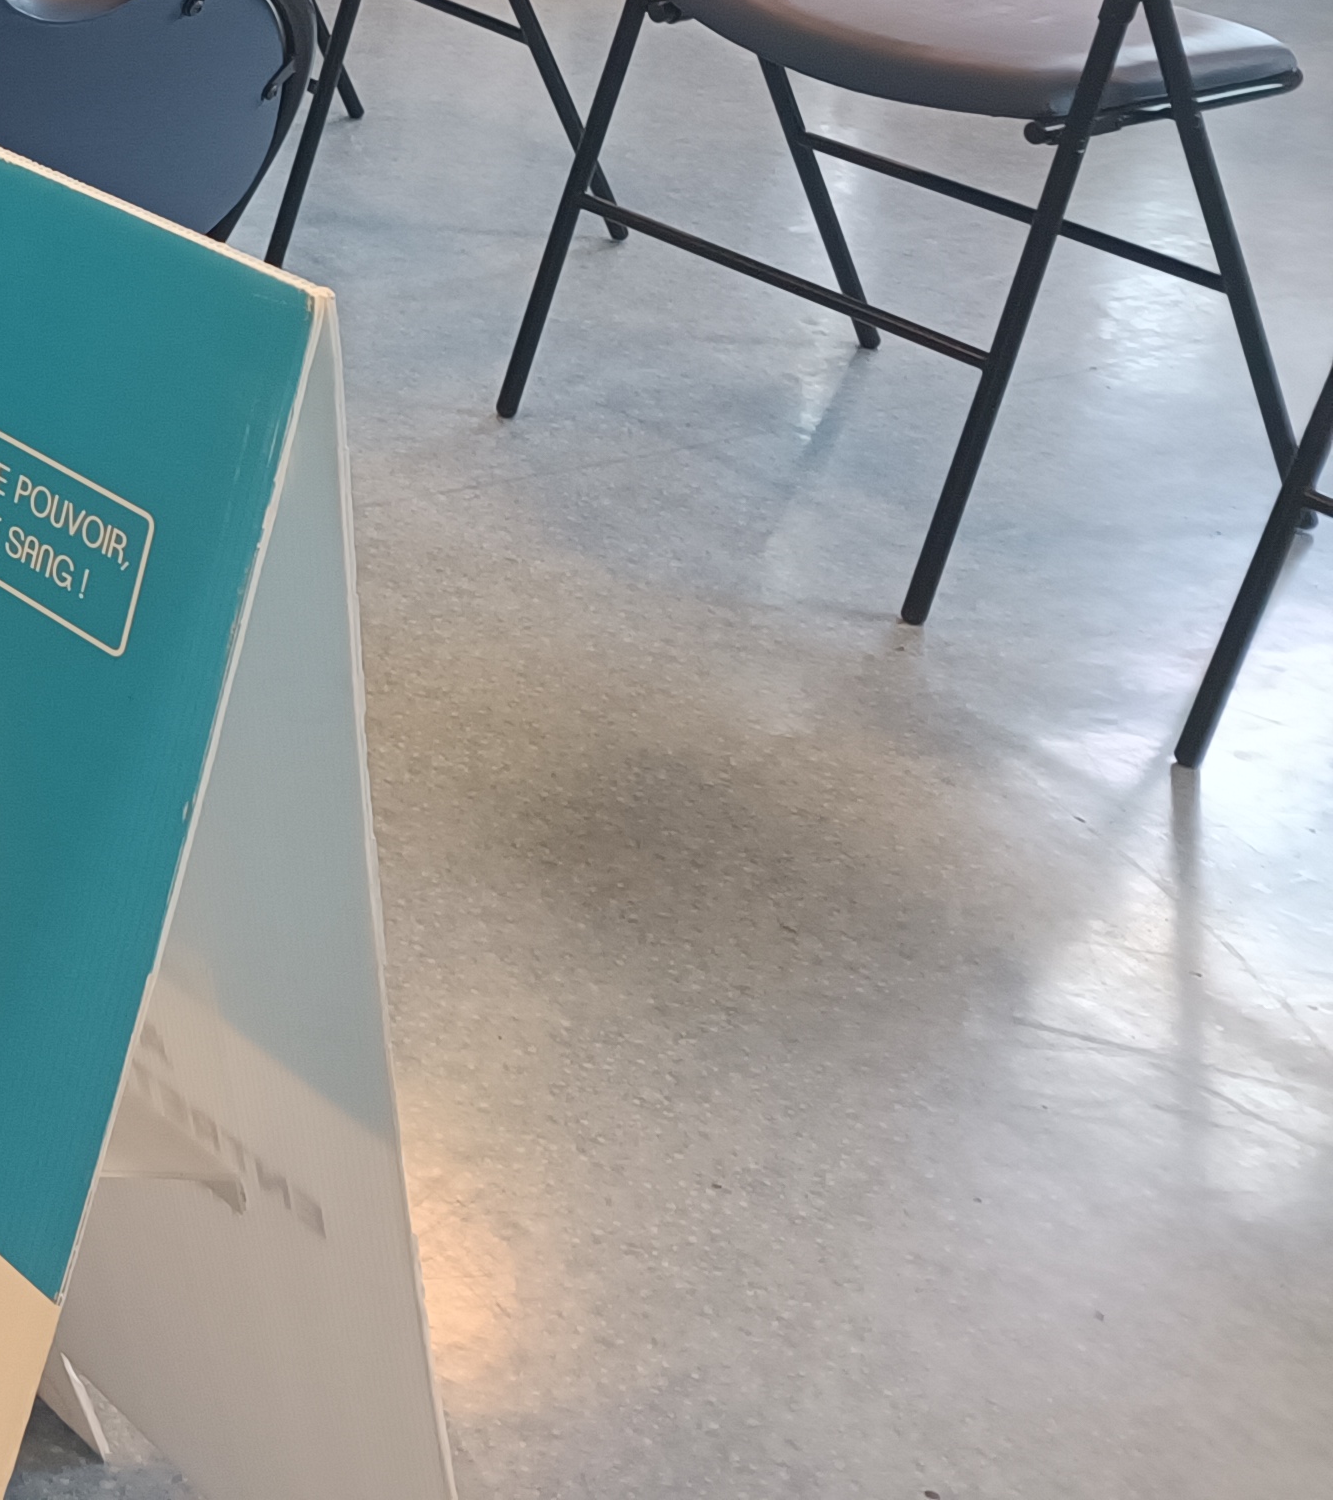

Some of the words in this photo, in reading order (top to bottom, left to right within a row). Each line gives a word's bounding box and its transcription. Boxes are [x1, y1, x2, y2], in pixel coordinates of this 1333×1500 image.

[5, 526, 76, 591] SANG
[78, 569, 90, 599] !
[13, 473, 130, 571] POUVOIR,
